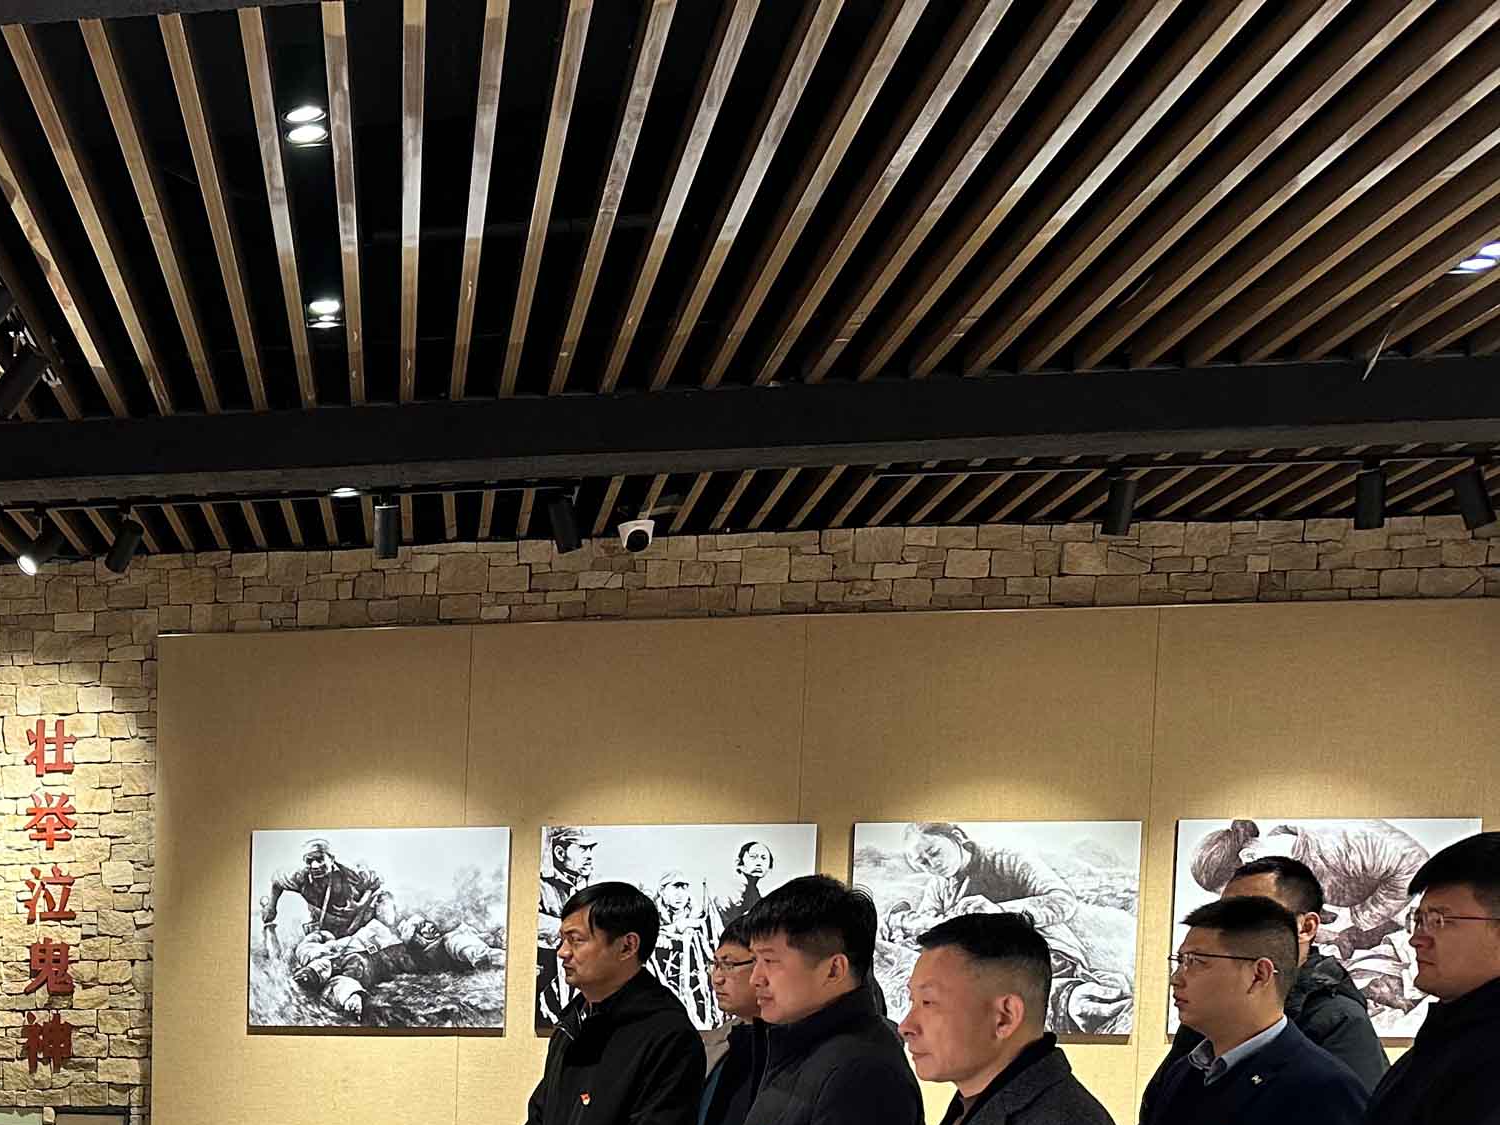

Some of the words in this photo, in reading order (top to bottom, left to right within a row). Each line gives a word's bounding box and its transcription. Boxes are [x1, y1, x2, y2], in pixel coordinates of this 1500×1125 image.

[23, 719, 77, 1073] 壮举泣鬼神
